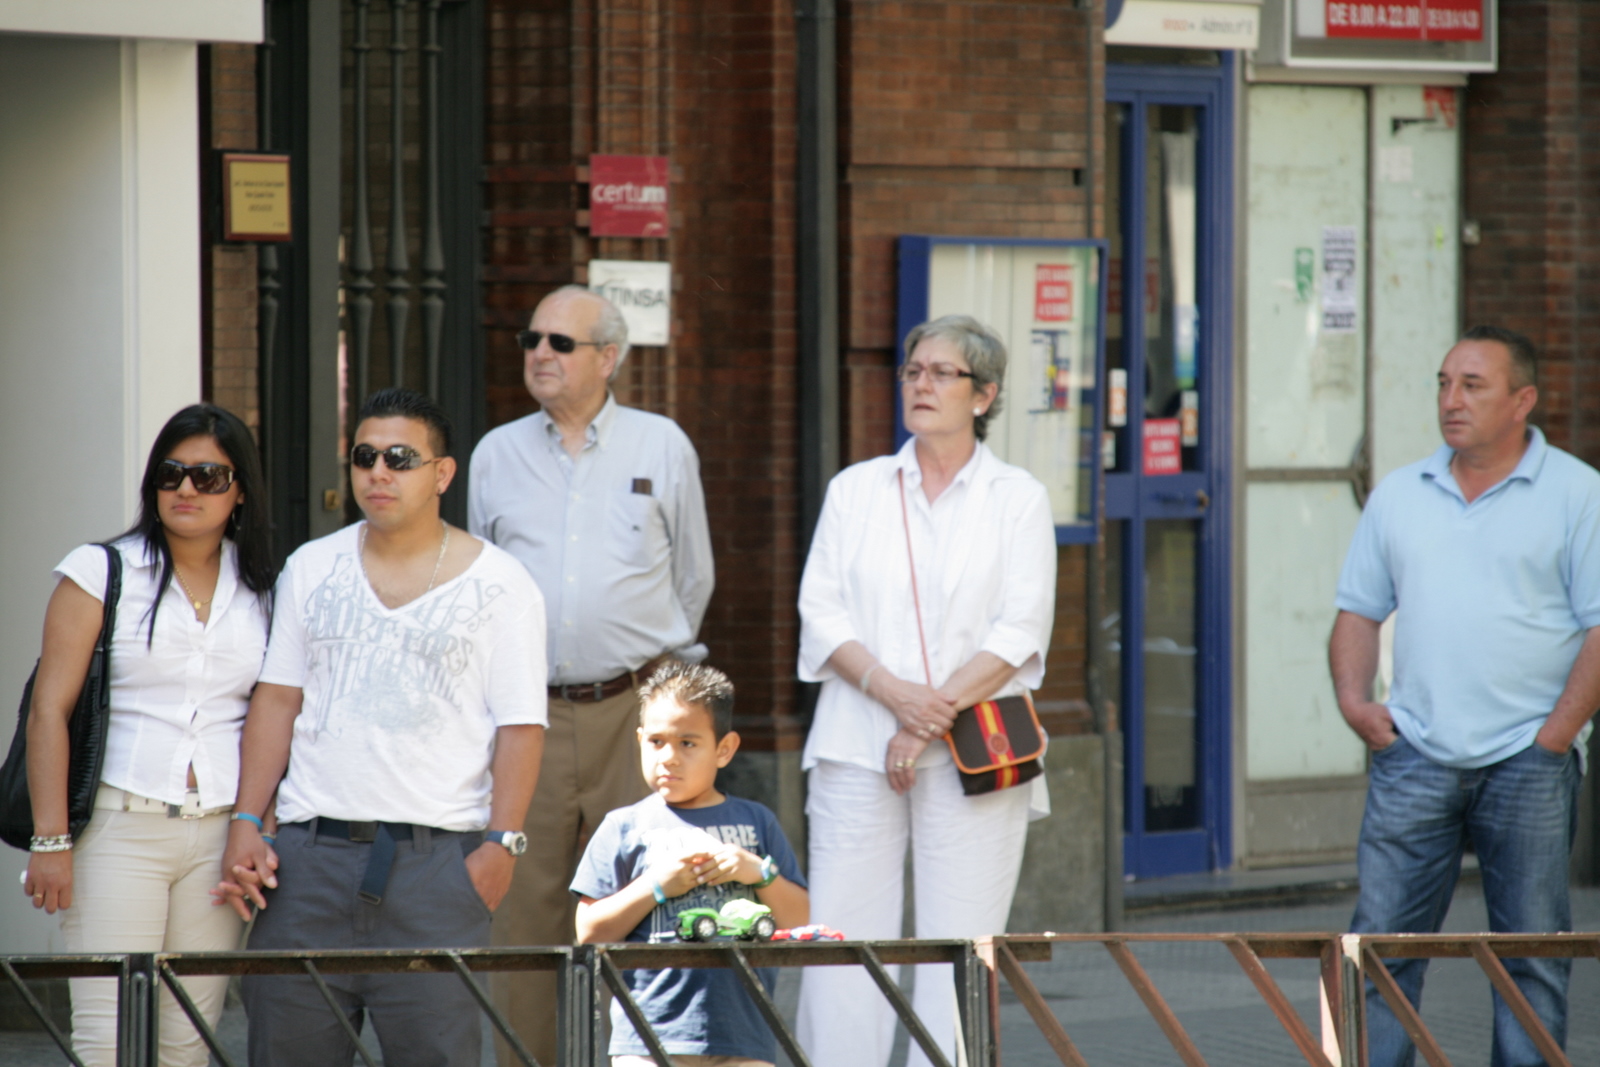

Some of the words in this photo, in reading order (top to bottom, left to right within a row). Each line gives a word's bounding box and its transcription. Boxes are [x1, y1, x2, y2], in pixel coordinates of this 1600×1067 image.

[1328, 2, 1349, 25] DE
[592, 182, 667, 204] certum
[609, 286, 669, 308] TINSA
